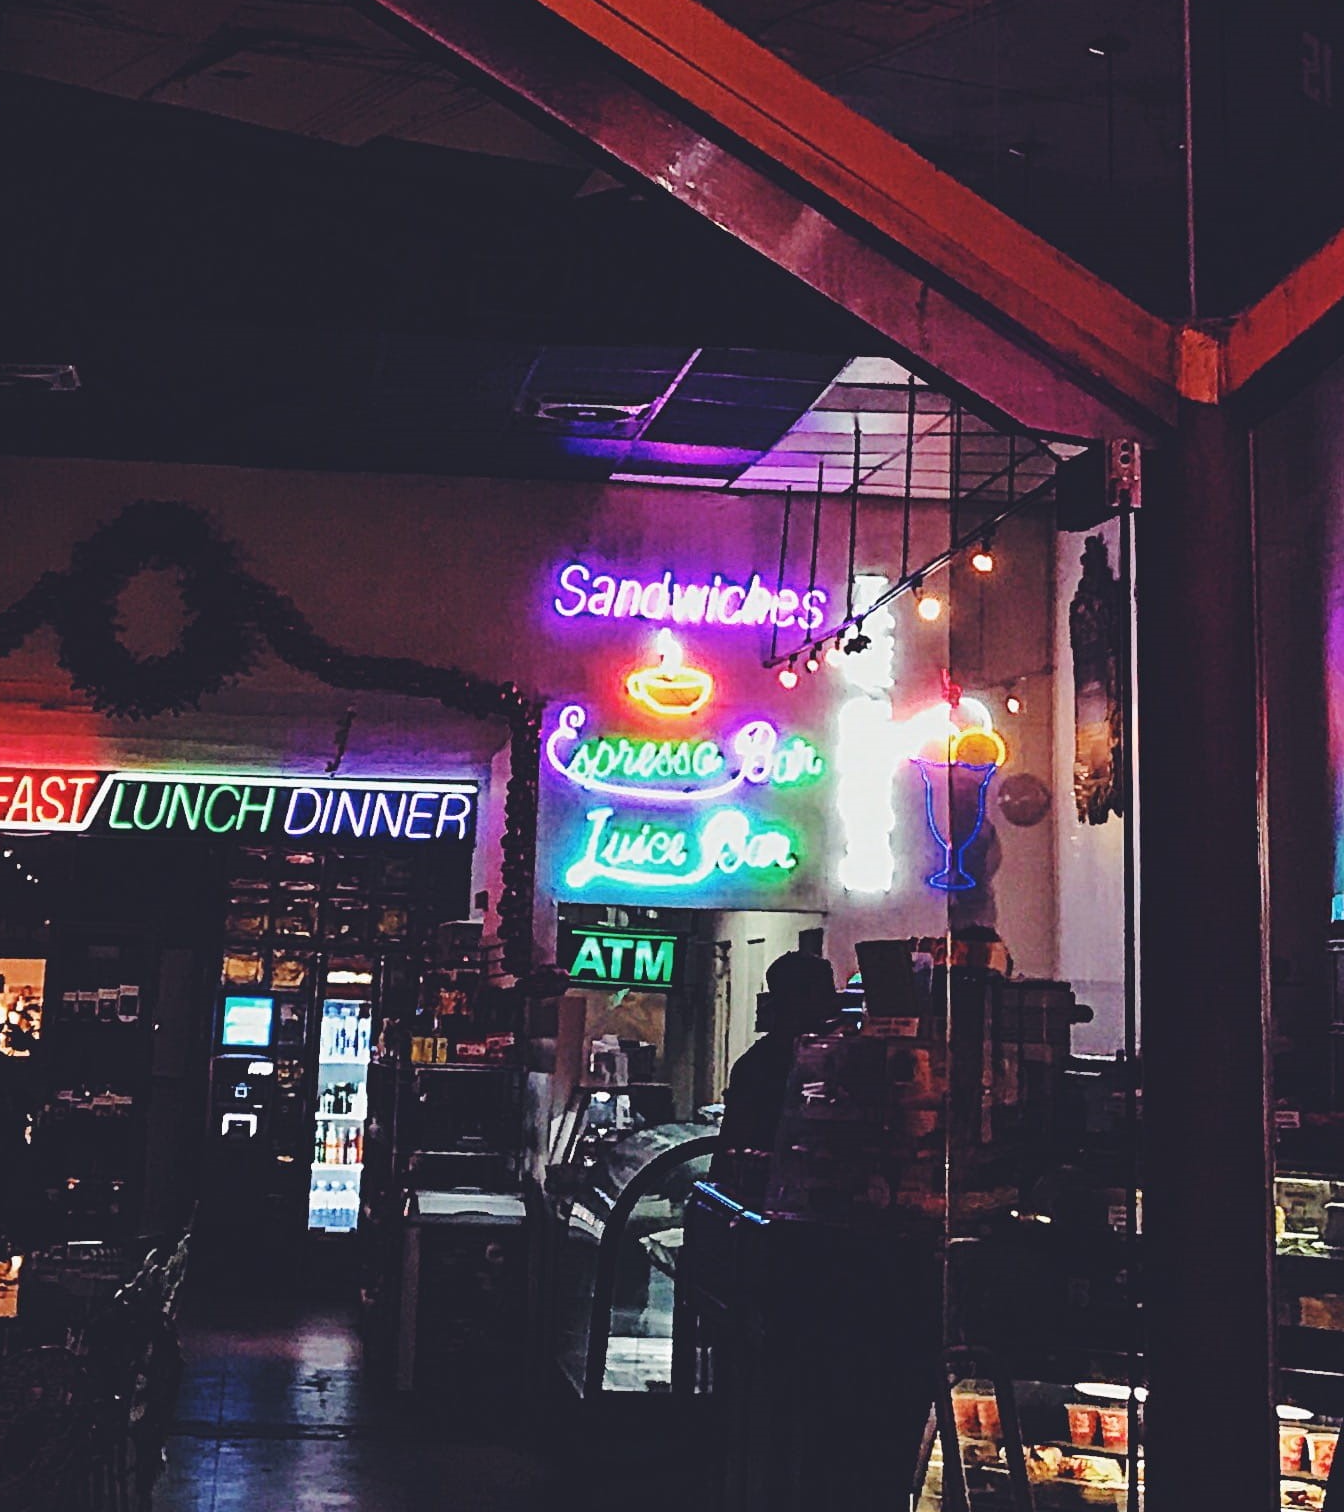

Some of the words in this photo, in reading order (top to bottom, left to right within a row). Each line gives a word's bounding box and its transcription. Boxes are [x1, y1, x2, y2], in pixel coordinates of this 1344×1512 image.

[555, 564, 827, 631] Sandwiches
[734, 721, 824, 784] Bar
[109, 782, 276, 834] LUNCH
[282, 788, 473, 841] DINNER
[569, 936, 675, 982] ATM
